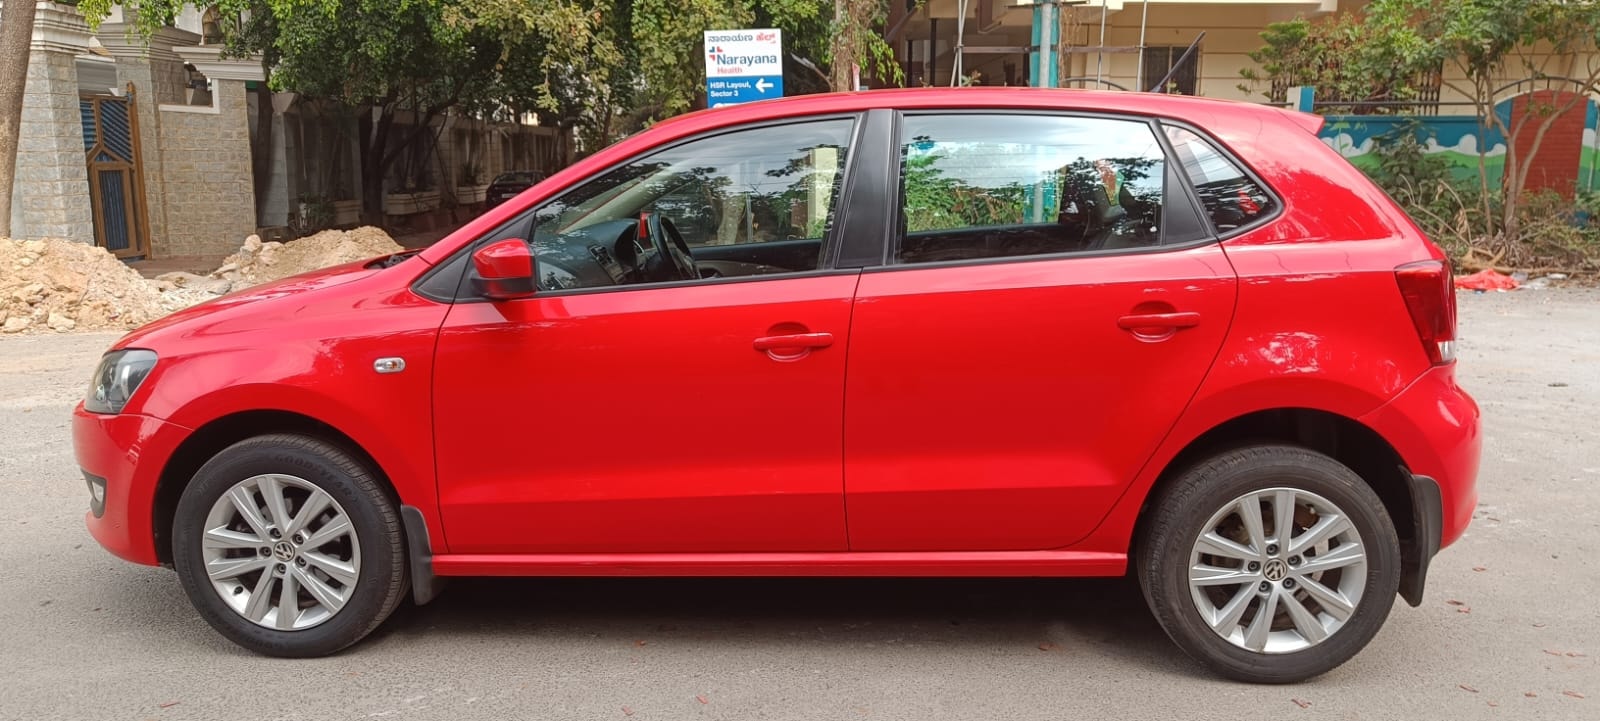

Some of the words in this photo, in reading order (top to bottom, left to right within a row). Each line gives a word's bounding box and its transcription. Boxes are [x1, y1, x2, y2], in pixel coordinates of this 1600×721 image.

[717, 54, 777, 66] Narayana
[717, 66, 743, 74] Health
[710, 81, 725, 89] HSR
[726, 81, 752, 90] Layout,
